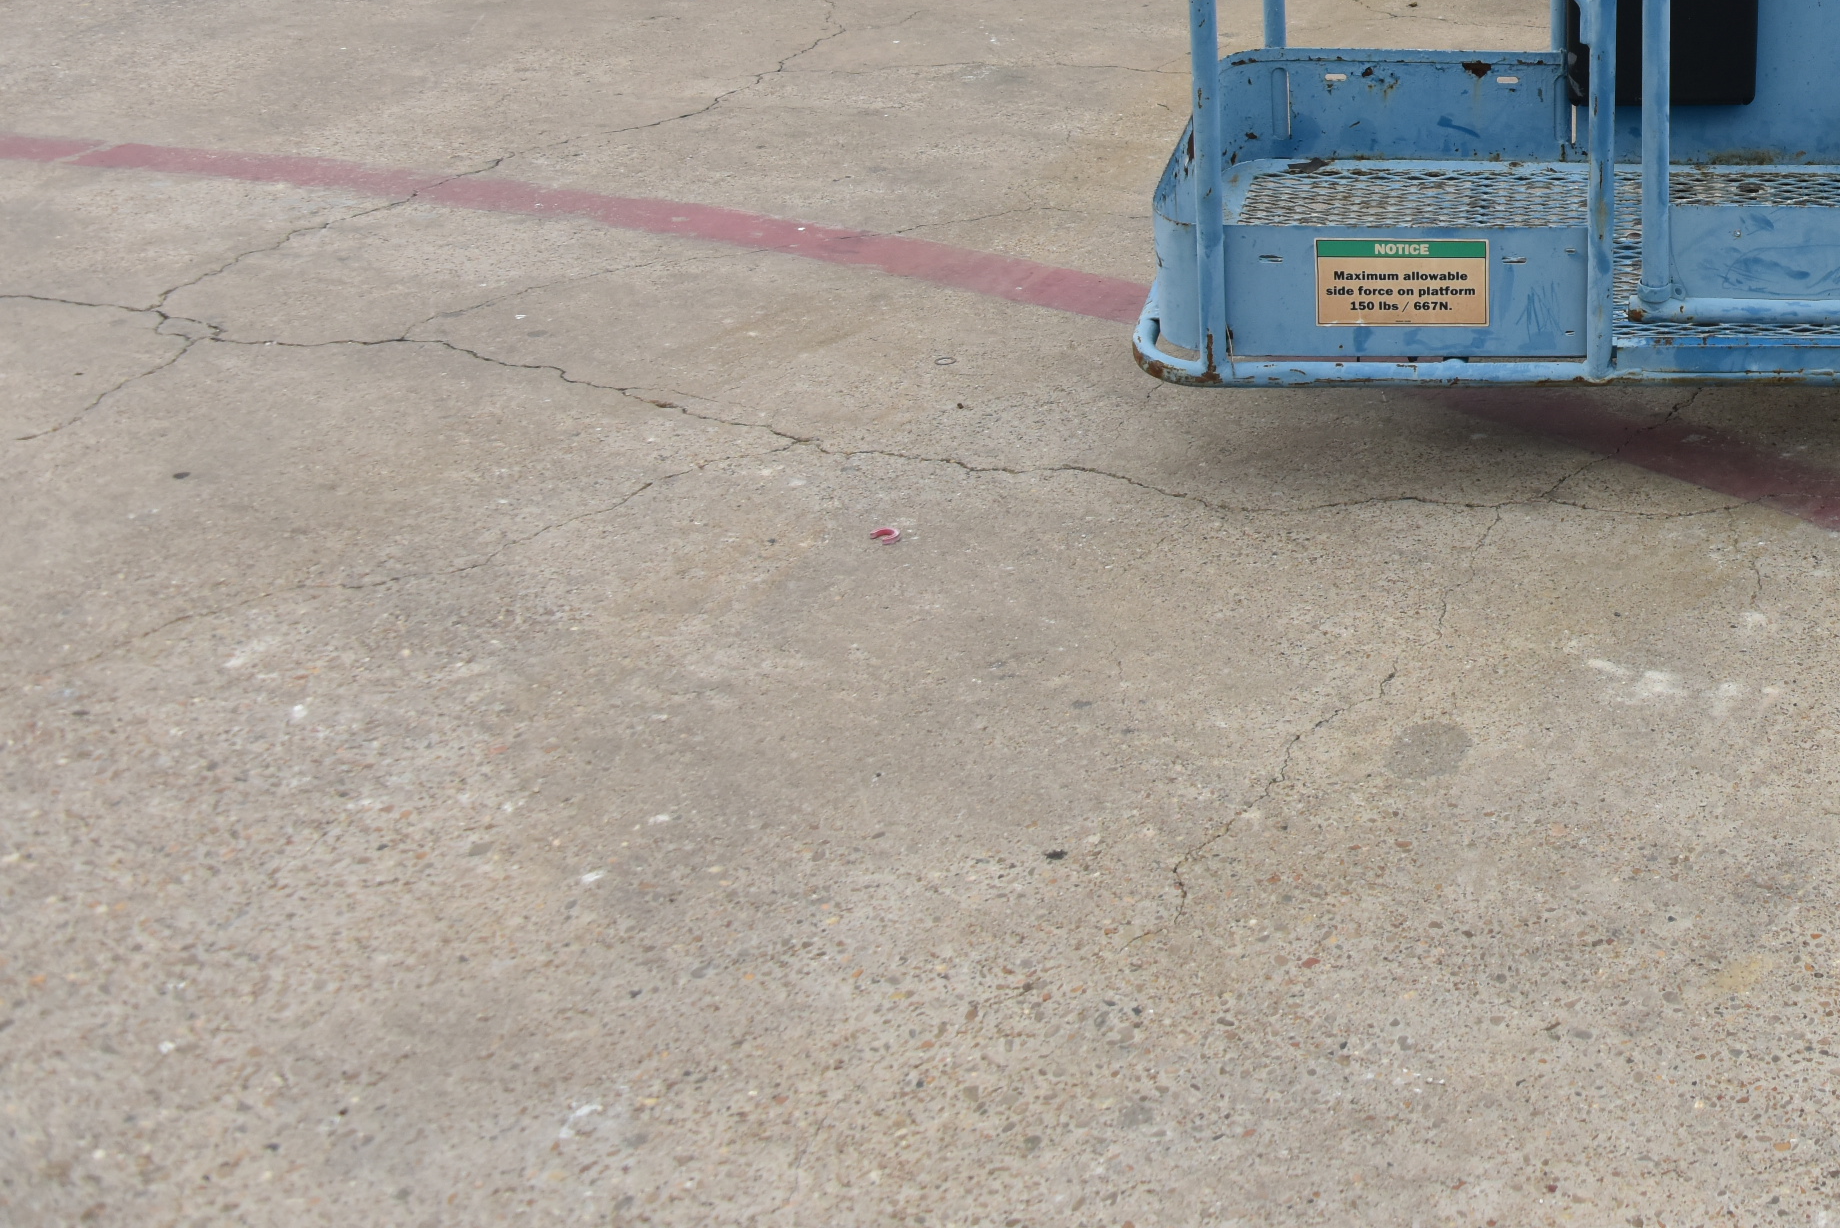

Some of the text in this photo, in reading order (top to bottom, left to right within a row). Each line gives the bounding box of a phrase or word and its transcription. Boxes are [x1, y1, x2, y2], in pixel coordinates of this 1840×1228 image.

[1374, 243, 1430, 255] NOTICE
[1333, 271, 1468, 281] Maximum allowable
[1326, 286, 1476, 298] side force on platform
[1350, 301, 1452, 313] 150 lbs / 667N.
